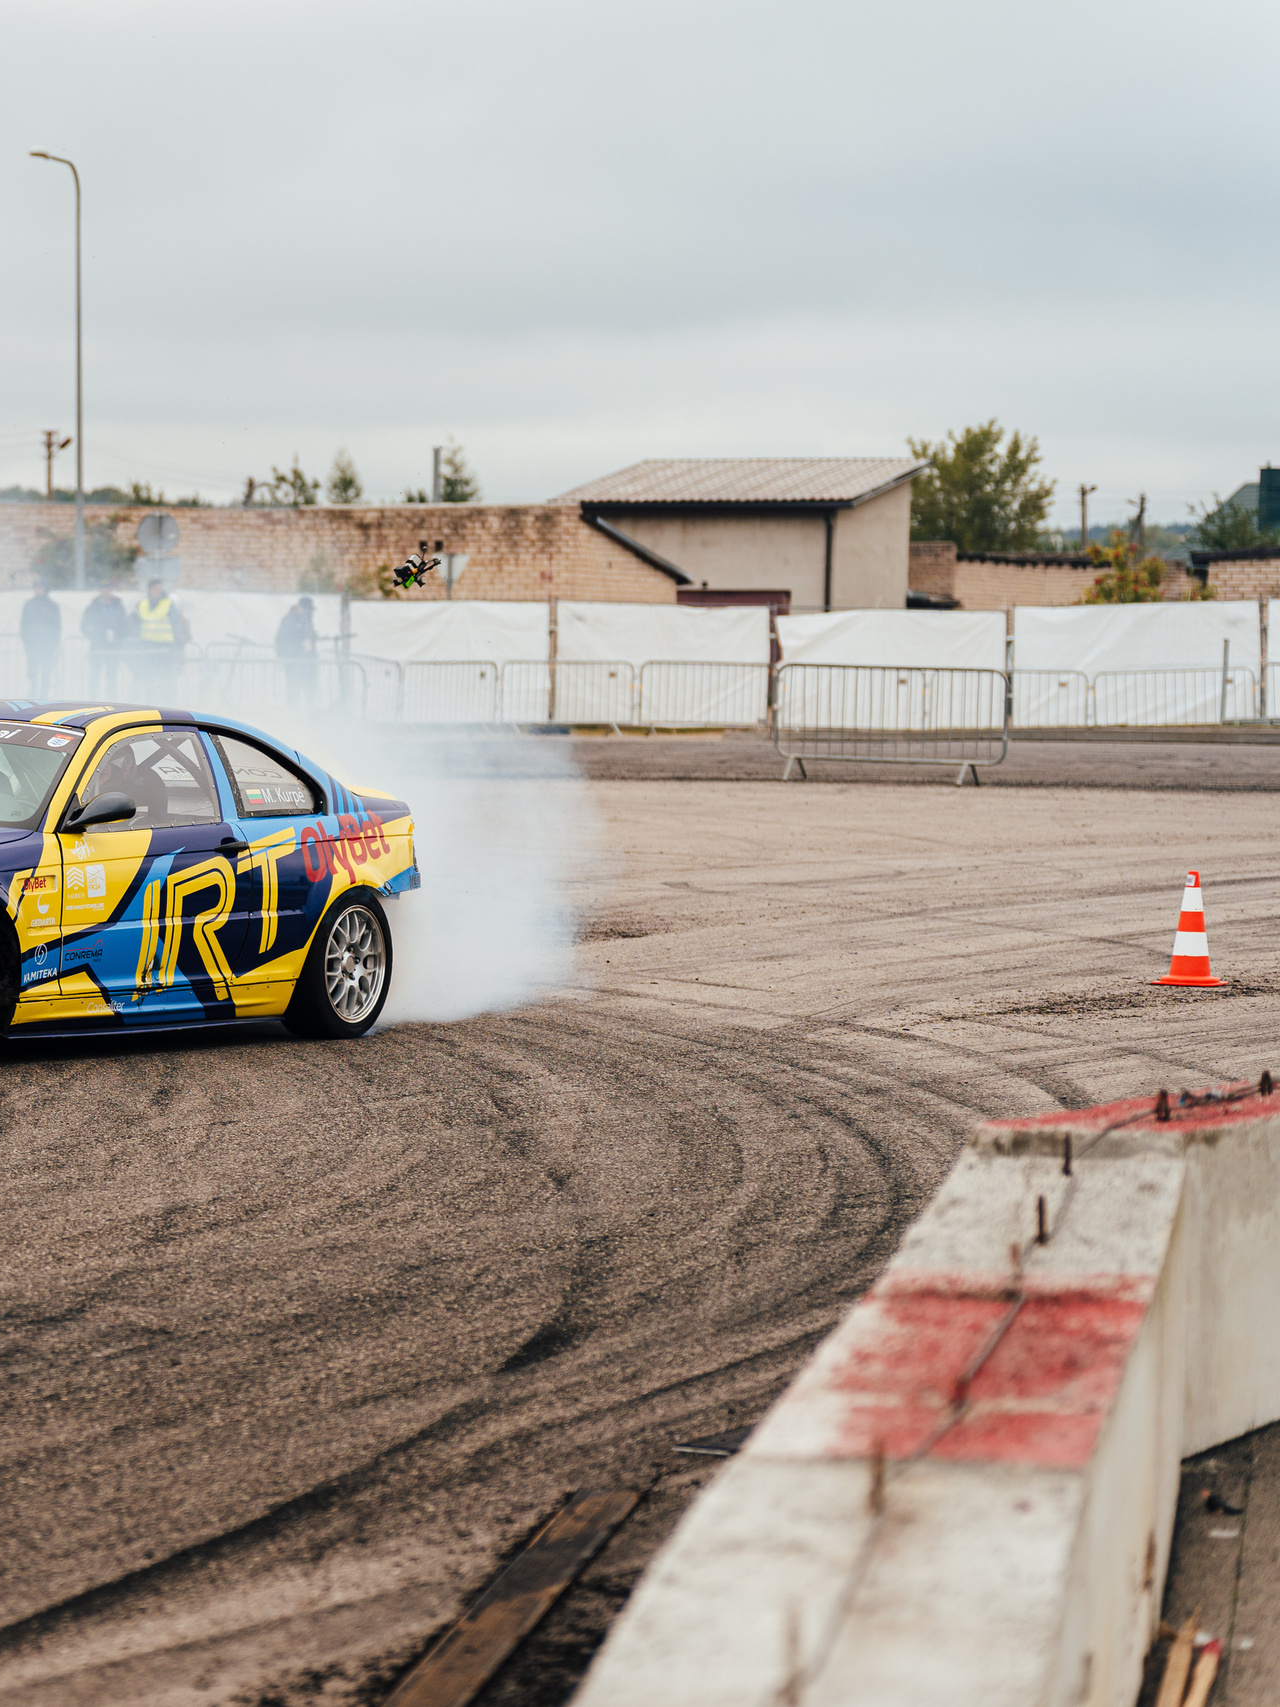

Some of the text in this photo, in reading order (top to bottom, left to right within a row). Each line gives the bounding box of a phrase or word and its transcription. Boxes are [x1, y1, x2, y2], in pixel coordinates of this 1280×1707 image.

[263, 787, 305, 806] M. Kurpė
[300, 809, 391, 886] OlyBet
[23, 877, 46, 892] OlyBet
[30, 917, 56, 927] GEDARTA
[64, 948, 103, 961] CONREMA
[23, 967, 58, 983] KAMITEKA
